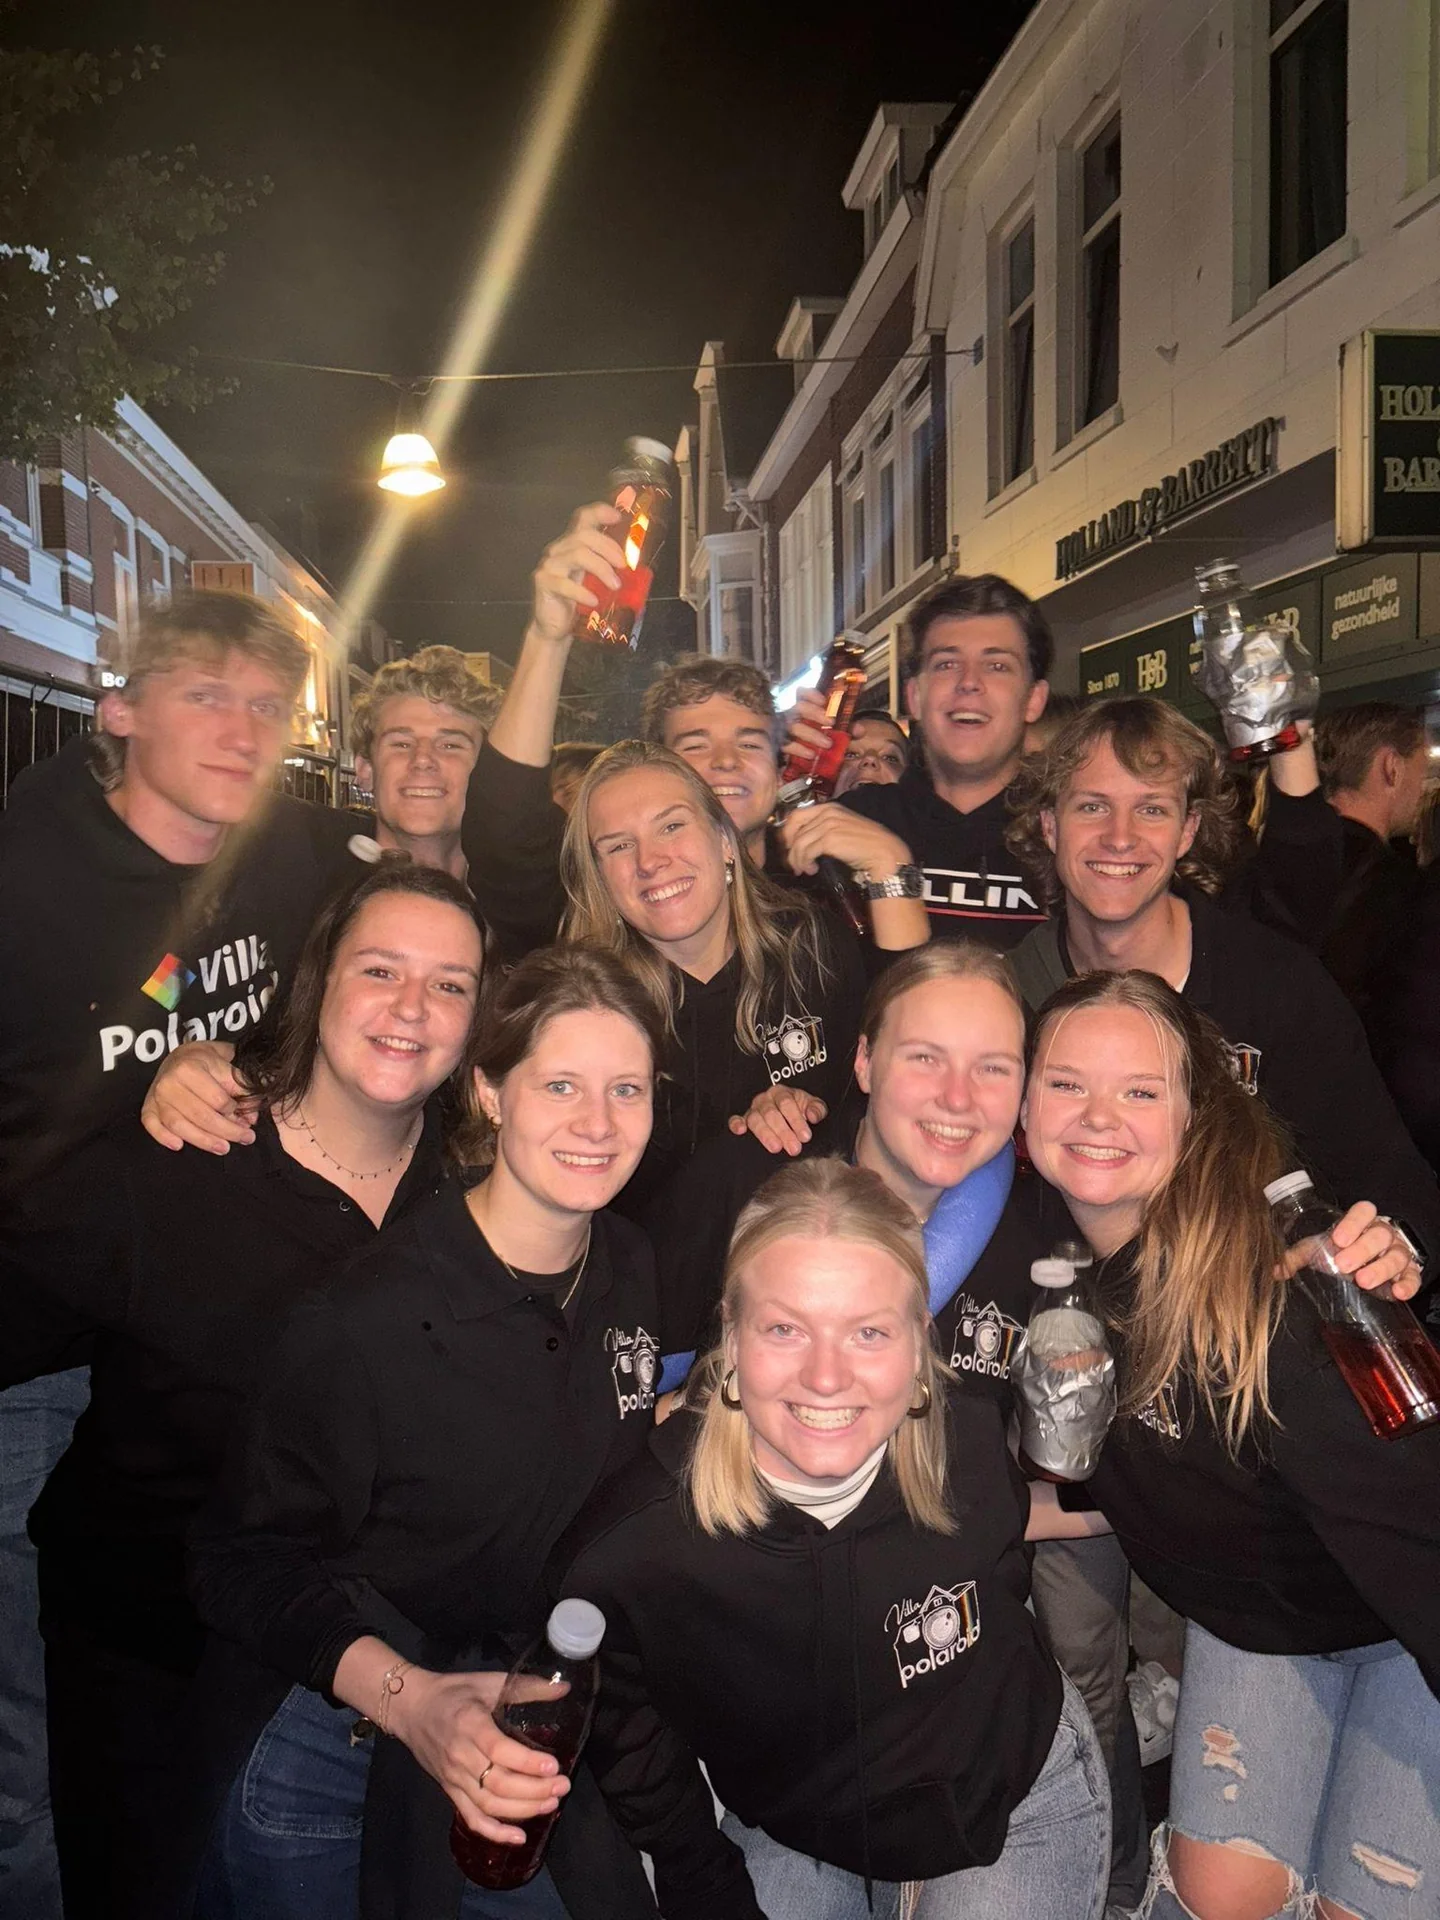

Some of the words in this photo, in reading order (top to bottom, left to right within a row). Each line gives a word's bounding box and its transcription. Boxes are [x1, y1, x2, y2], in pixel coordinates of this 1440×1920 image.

[1056, 499, 1138, 580] HOLLAND
[1160, 416, 1277, 516] BARRETT
[1334, 575, 1398, 611] natuurlijke
[1331, 597, 1400, 641] gezondheid
[1137, 649, 1168, 693] H&B
[198, 934, 268, 994] Villa
[770, 1046, 828, 1086] polaroid
[955, 1292, 981, 1315] Villa
[603, 1326, 635, 1352] Villa
[884, 1598, 922, 1632] Villa
[899, 1618, 981, 1689] polaroid
